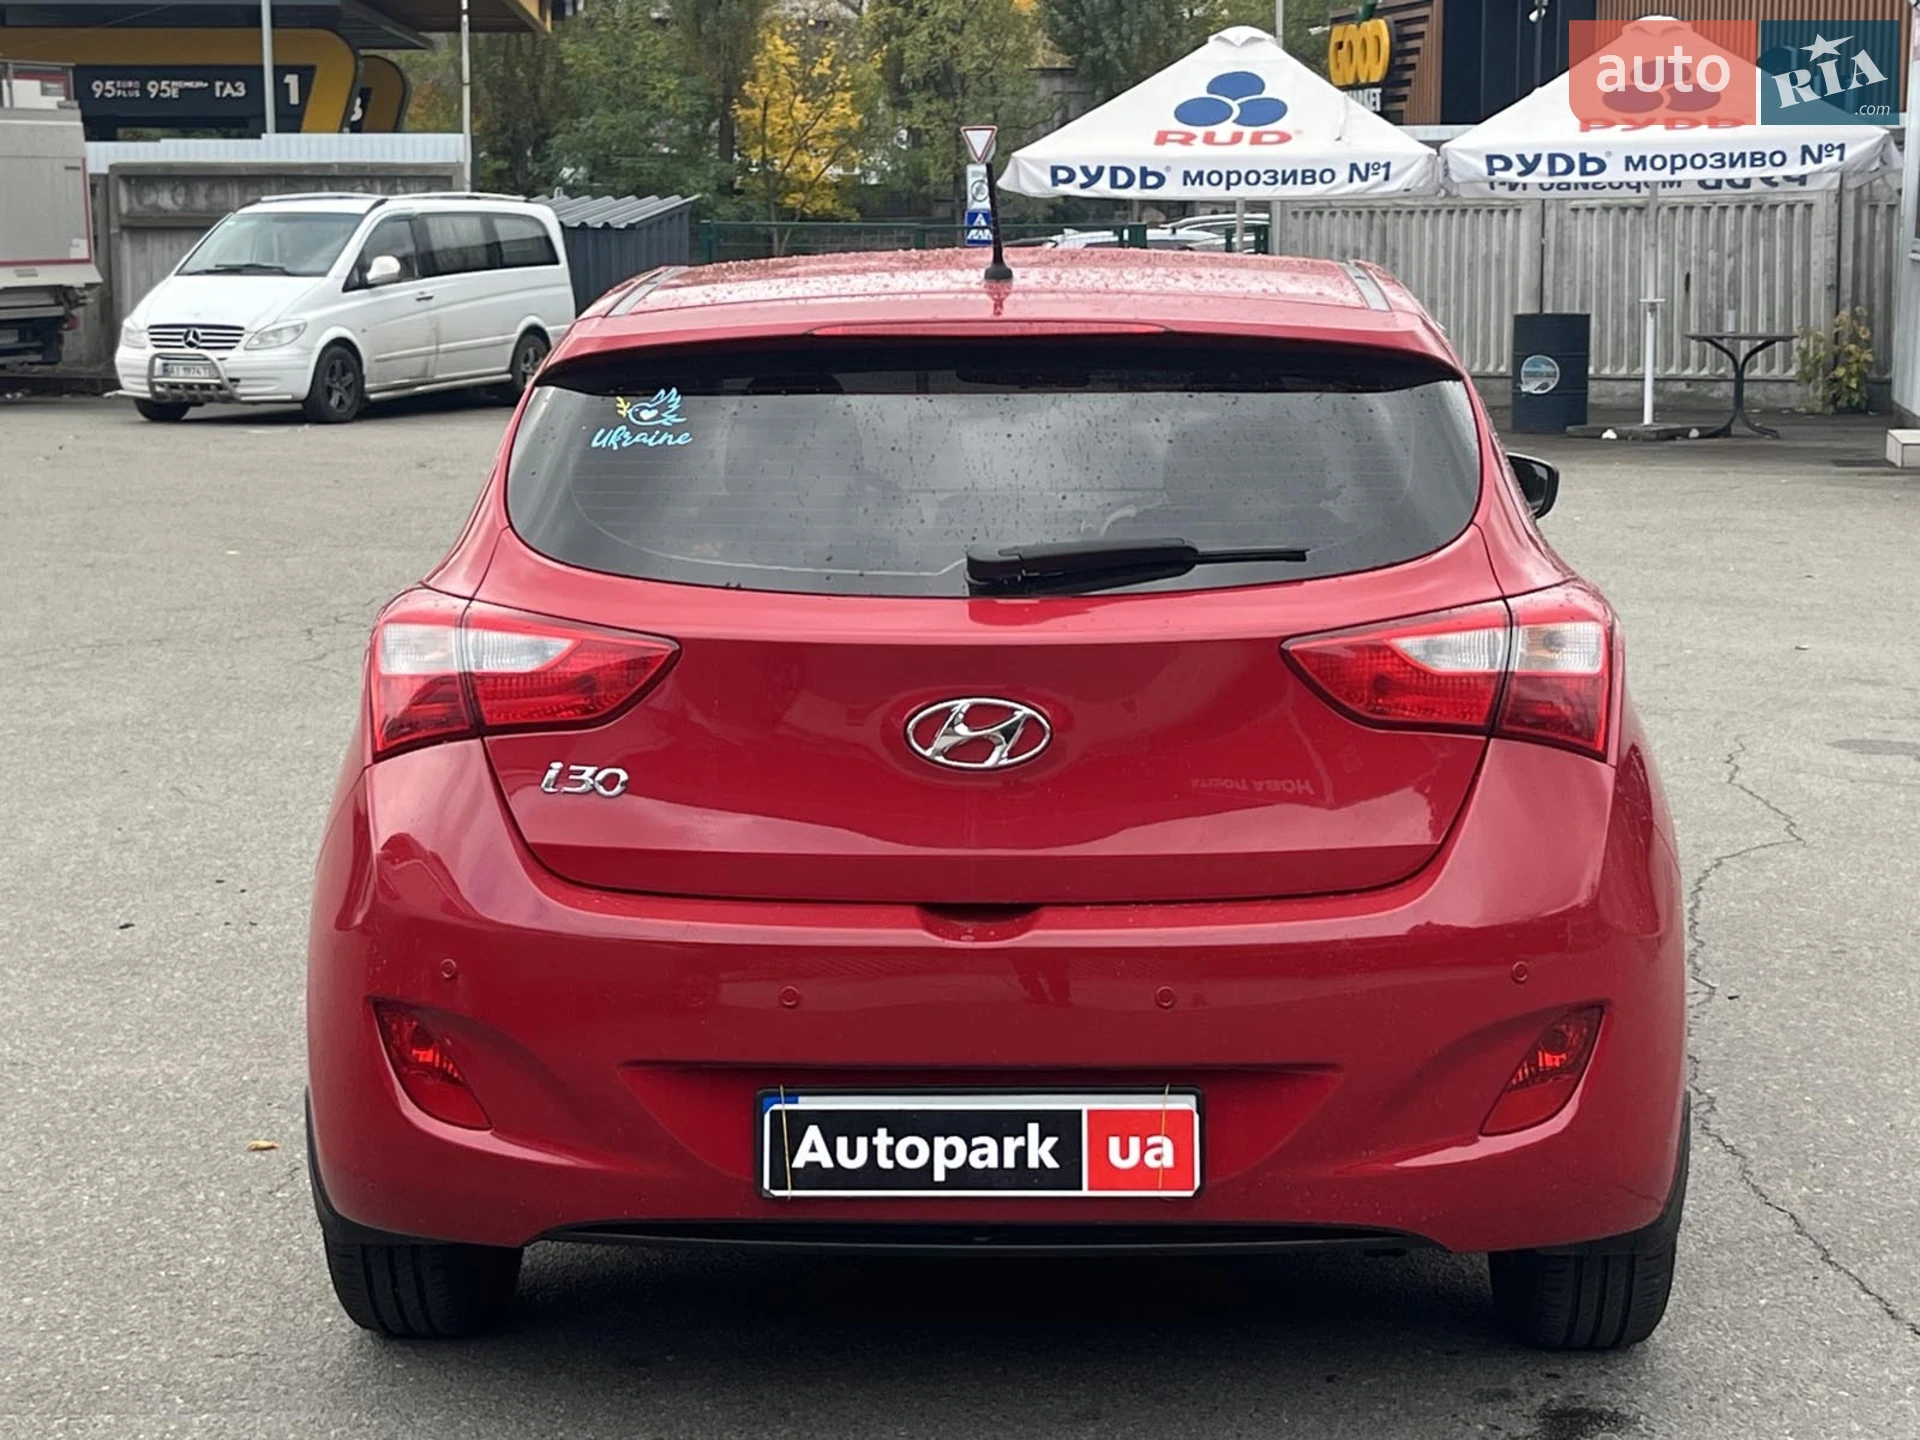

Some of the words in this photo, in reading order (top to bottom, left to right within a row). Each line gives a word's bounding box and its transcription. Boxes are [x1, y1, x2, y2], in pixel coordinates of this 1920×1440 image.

[1329, 18, 1391, 87] GOOD
[91, 80, 116, 98] 95
[214, 81, 246, 97] ГАЗ
[283, 74, 300, 105] 1
[1153, 130, 1293, 146] RUD
[1485, 151, 1608, 177] РУДЬ
[1624, 152, 1788, 175] морозиво
[1800, 143, 1846, 166] №1
[1050, 165, 1167, 190] РУДЬ
[1182, 167, 1336, 191] морозиво
[1347, 161, 1392, 184] №1
[591, 425, 693, 451] Ukraine
[541, 761, 629, 797] i30
[791, 1122, 1060, 1182] Autopark
[1108, 1135, 1174, 1169] ua
